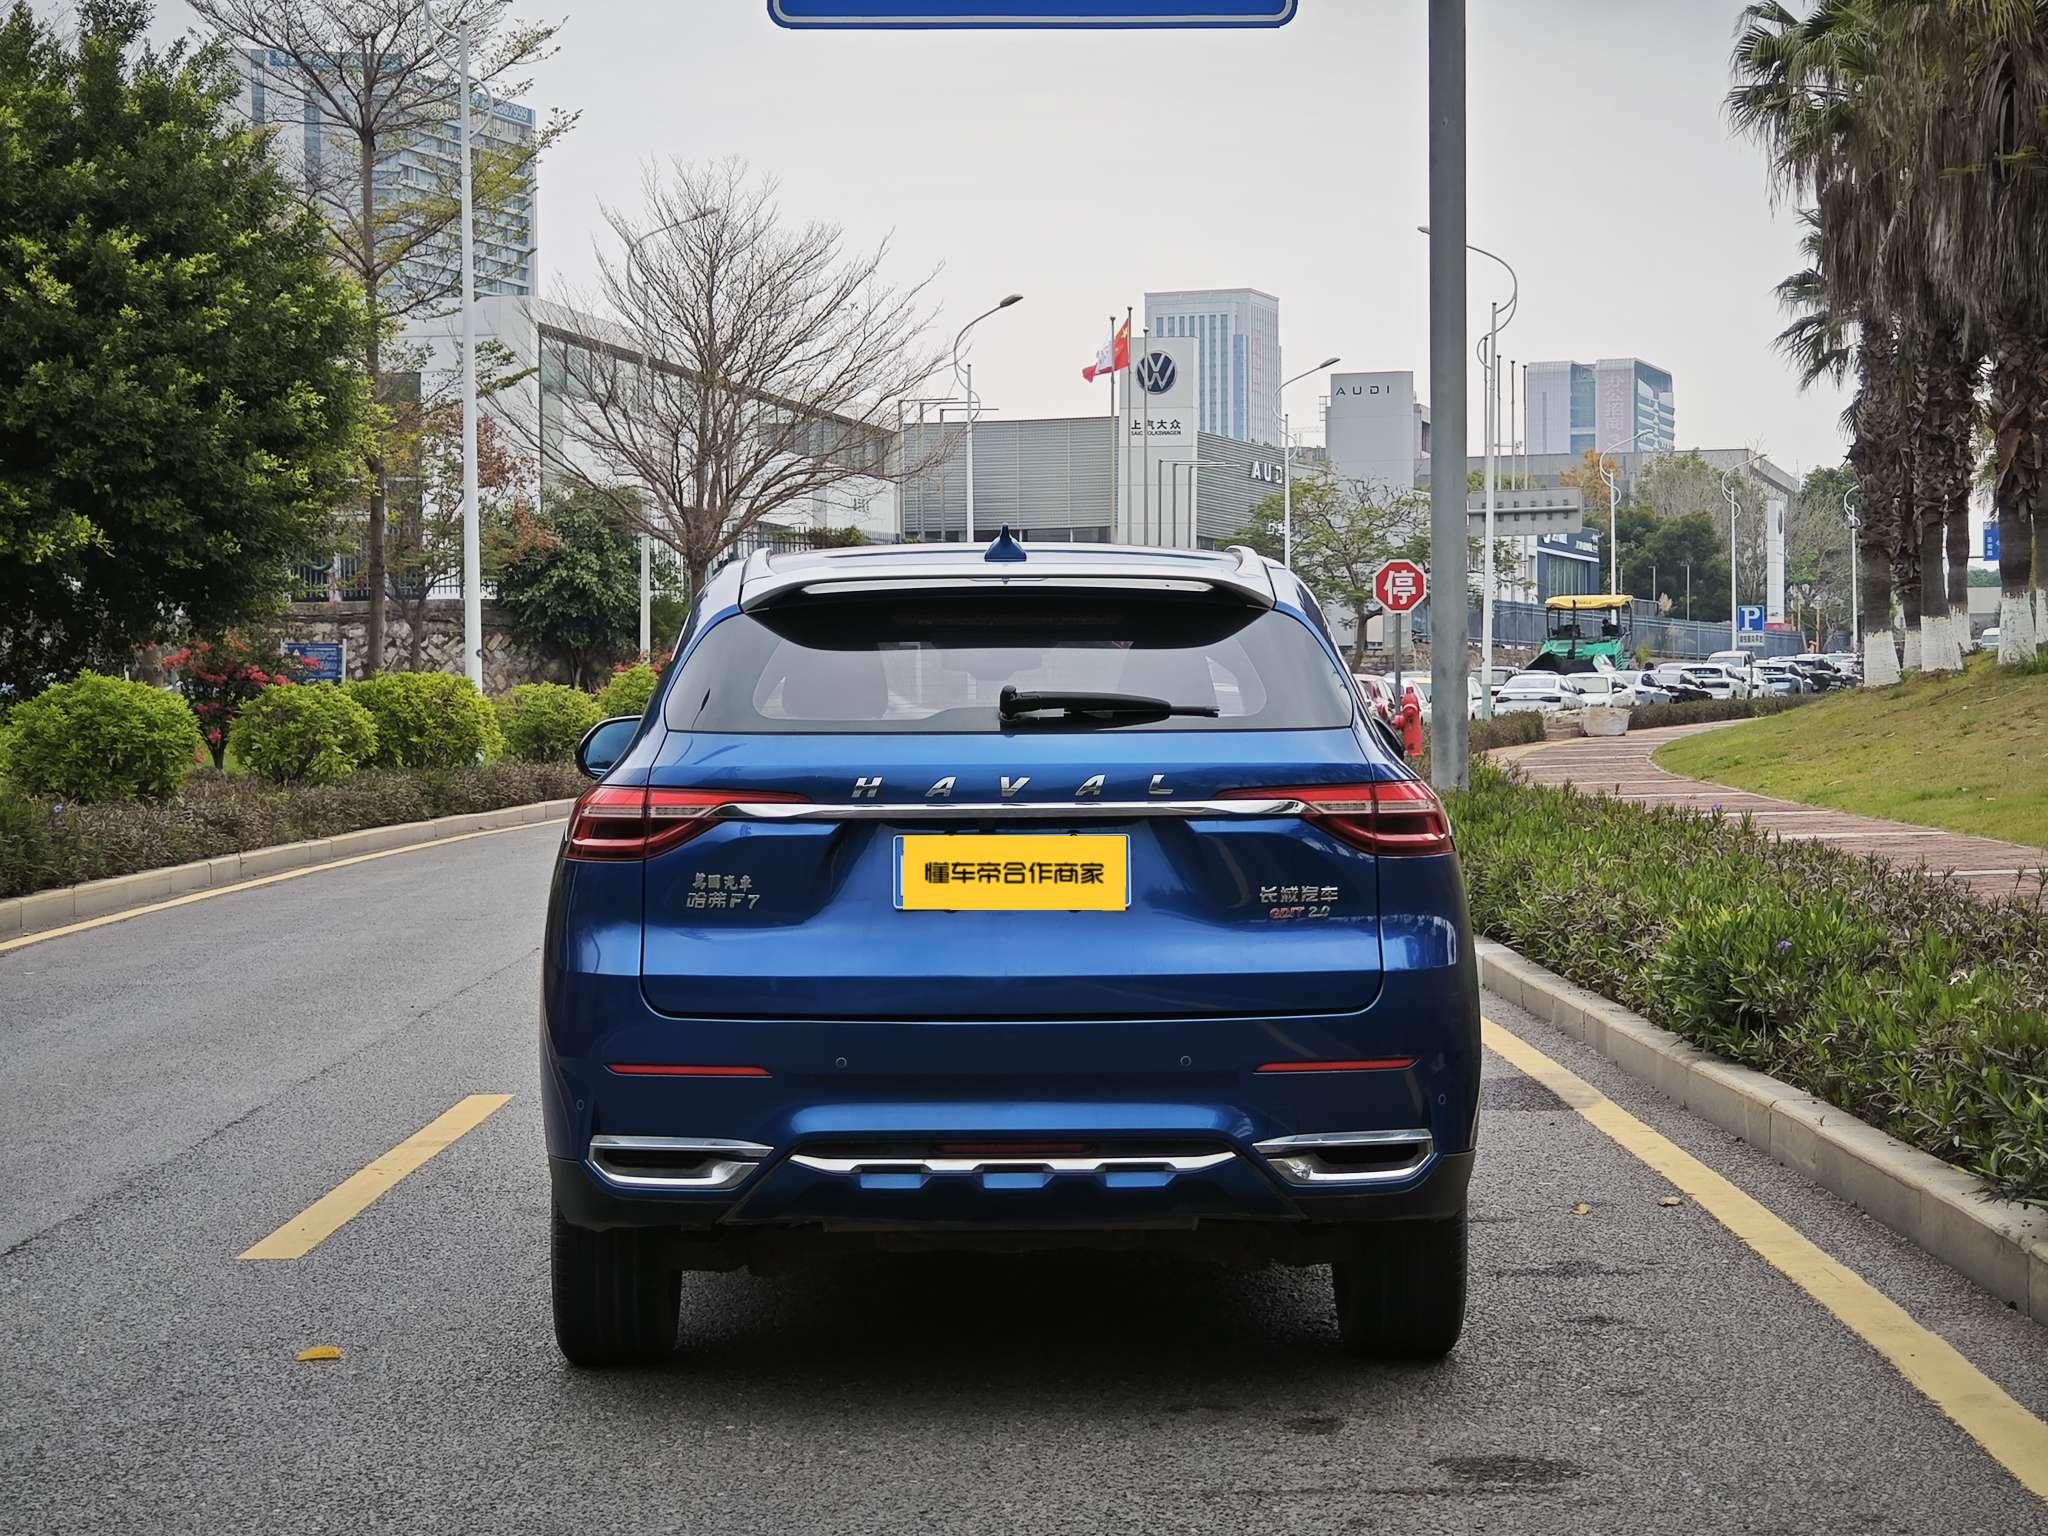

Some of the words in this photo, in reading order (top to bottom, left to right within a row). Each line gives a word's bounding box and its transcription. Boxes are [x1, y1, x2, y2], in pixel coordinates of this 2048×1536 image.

[1336, 385, 1390, 396] AUDI
[1250, 460, 1284, 484] AUD
[1383, 569, 1416, 605] 停
[1741, 607, 1760, 631] P
[852, 774, 1174, 798] HAVAL
[1259, 885, 1339, 903] 长城汽车
